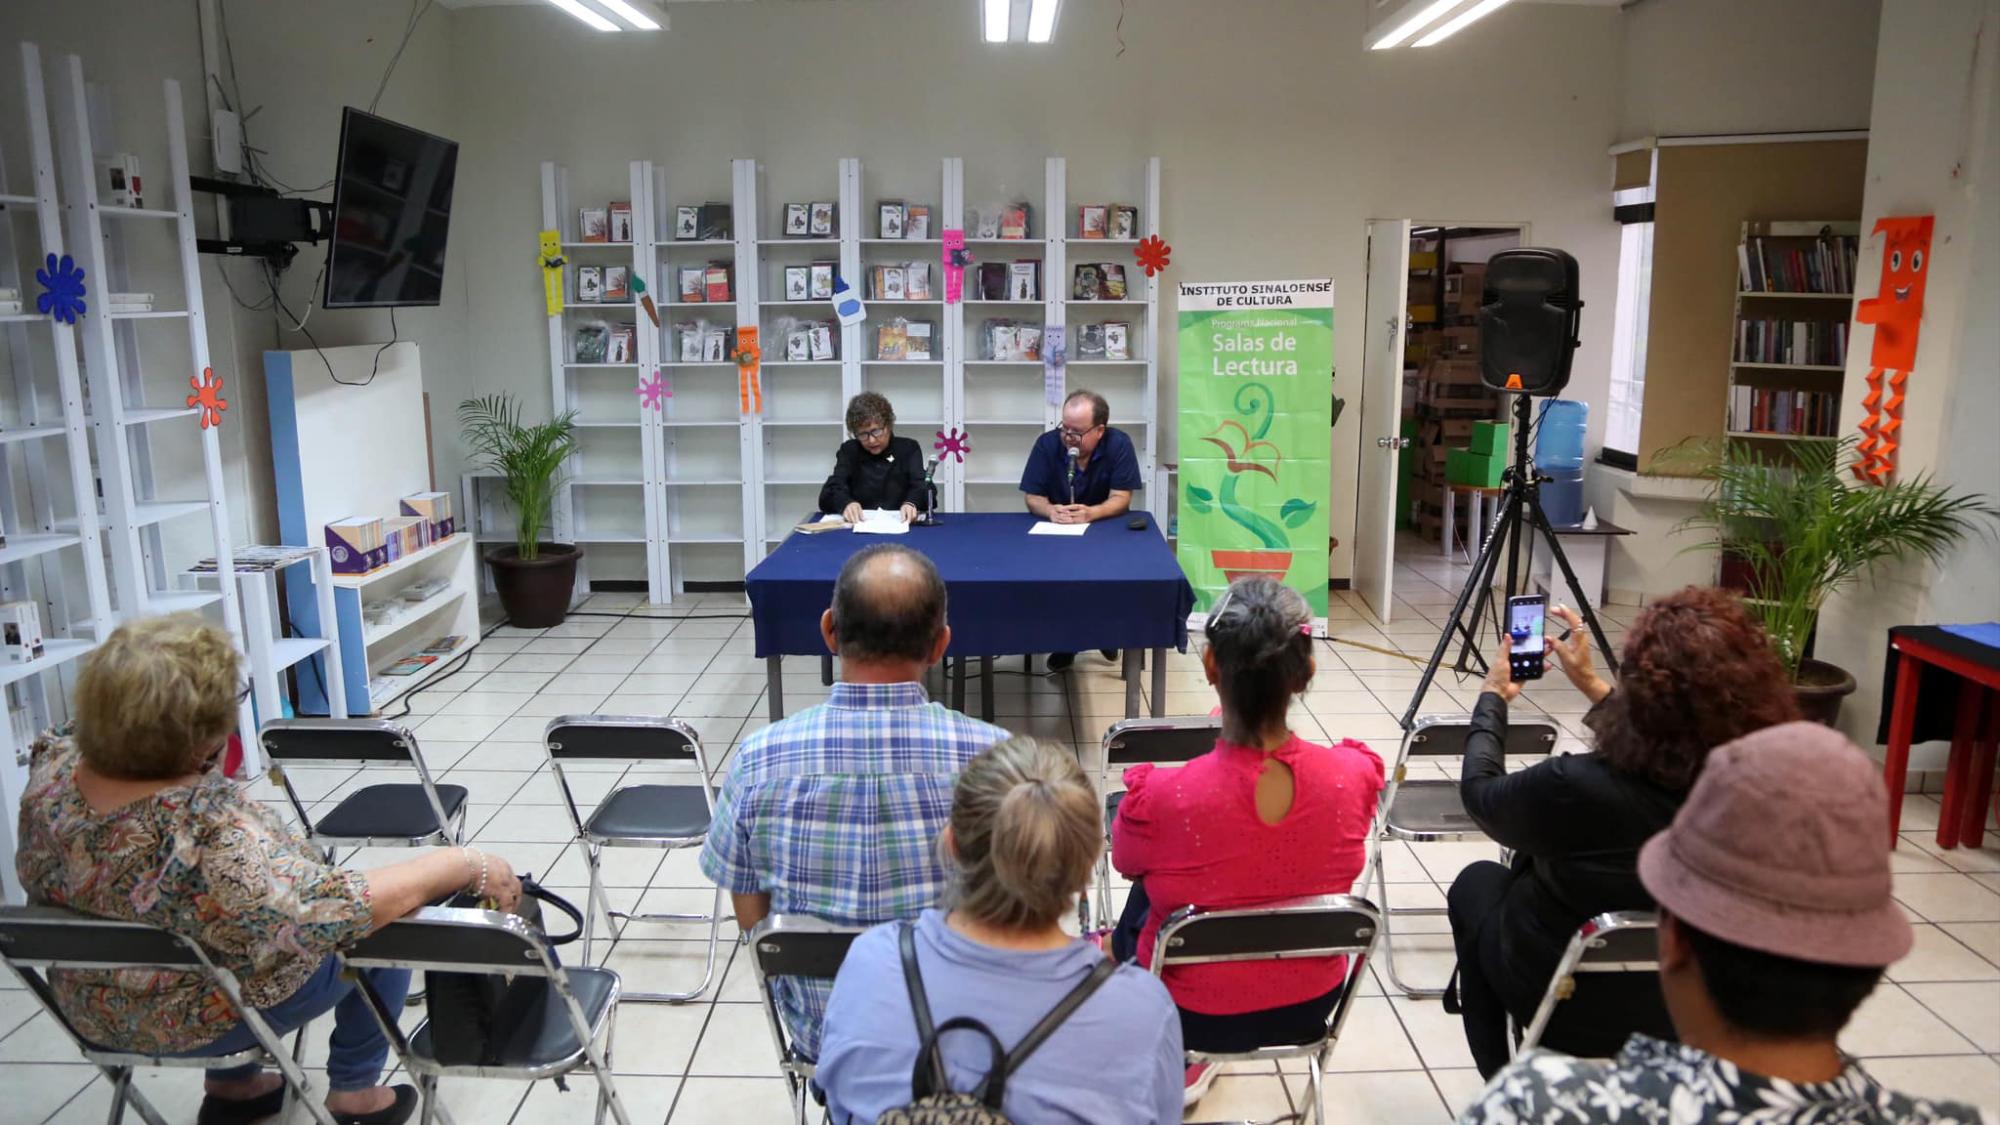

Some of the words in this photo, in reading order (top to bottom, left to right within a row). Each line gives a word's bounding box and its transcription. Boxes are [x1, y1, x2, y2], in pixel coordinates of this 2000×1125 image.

[1182, 285, 1248, 296] INSTITUTO
[1251, 282, 1330, 294] SINALOENSE
[1217, 297, 1233, 306] DE
[1236, 296, 1293, 306] CULTURA
[1213, 332, 1264, 352] Salas
[1271, 332, 1296, 351] de
[1213, 356, 1297, 376] Lectura
